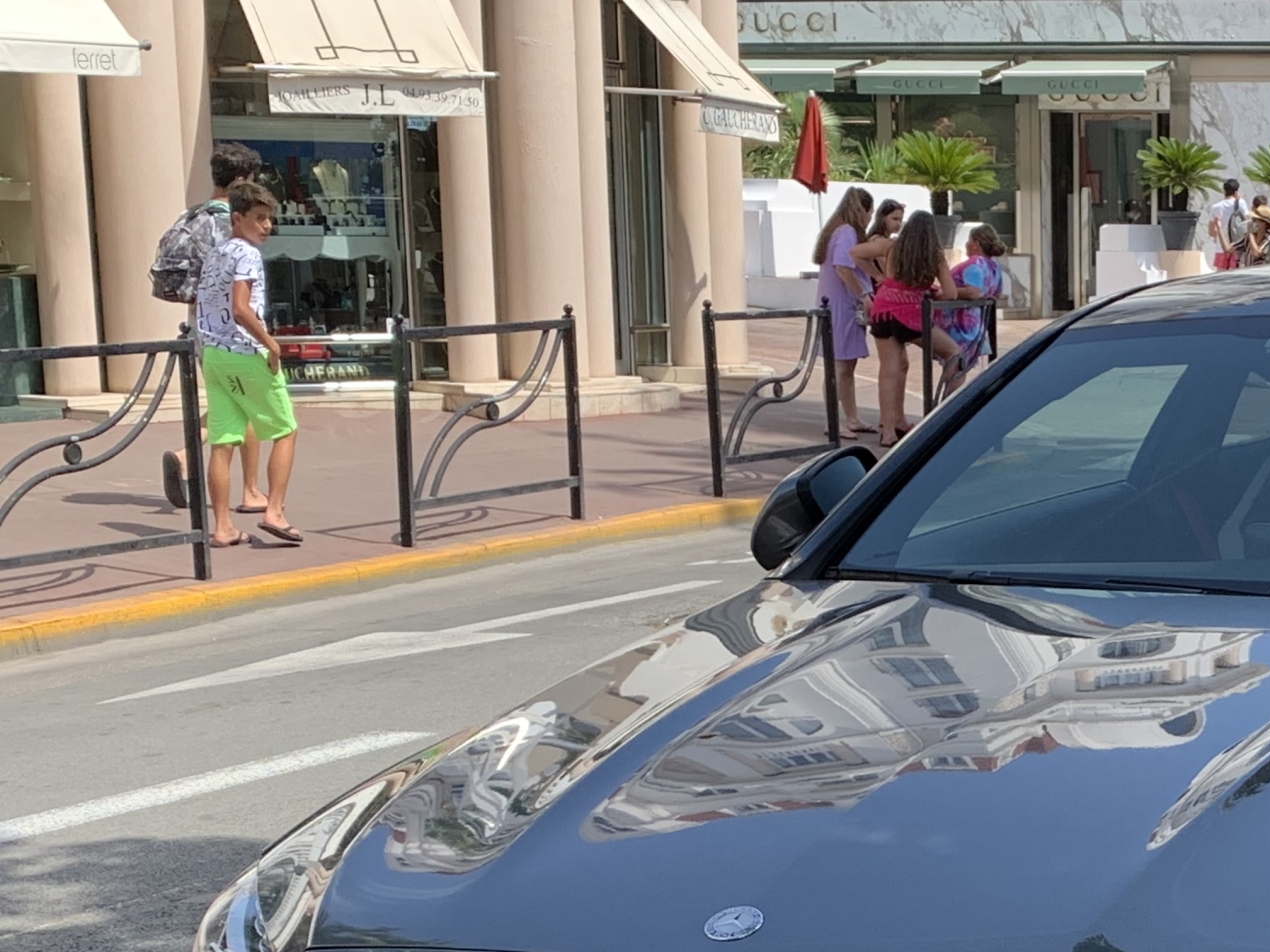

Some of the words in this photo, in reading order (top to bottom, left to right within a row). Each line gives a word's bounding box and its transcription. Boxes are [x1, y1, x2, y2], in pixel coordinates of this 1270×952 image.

[72, 47, 118, 70] ferret
[893, 79, 943, 89] GUCCI
[1047, 80, 1099, 90] GUCCI
[361, 84, 395, 106] J.L
